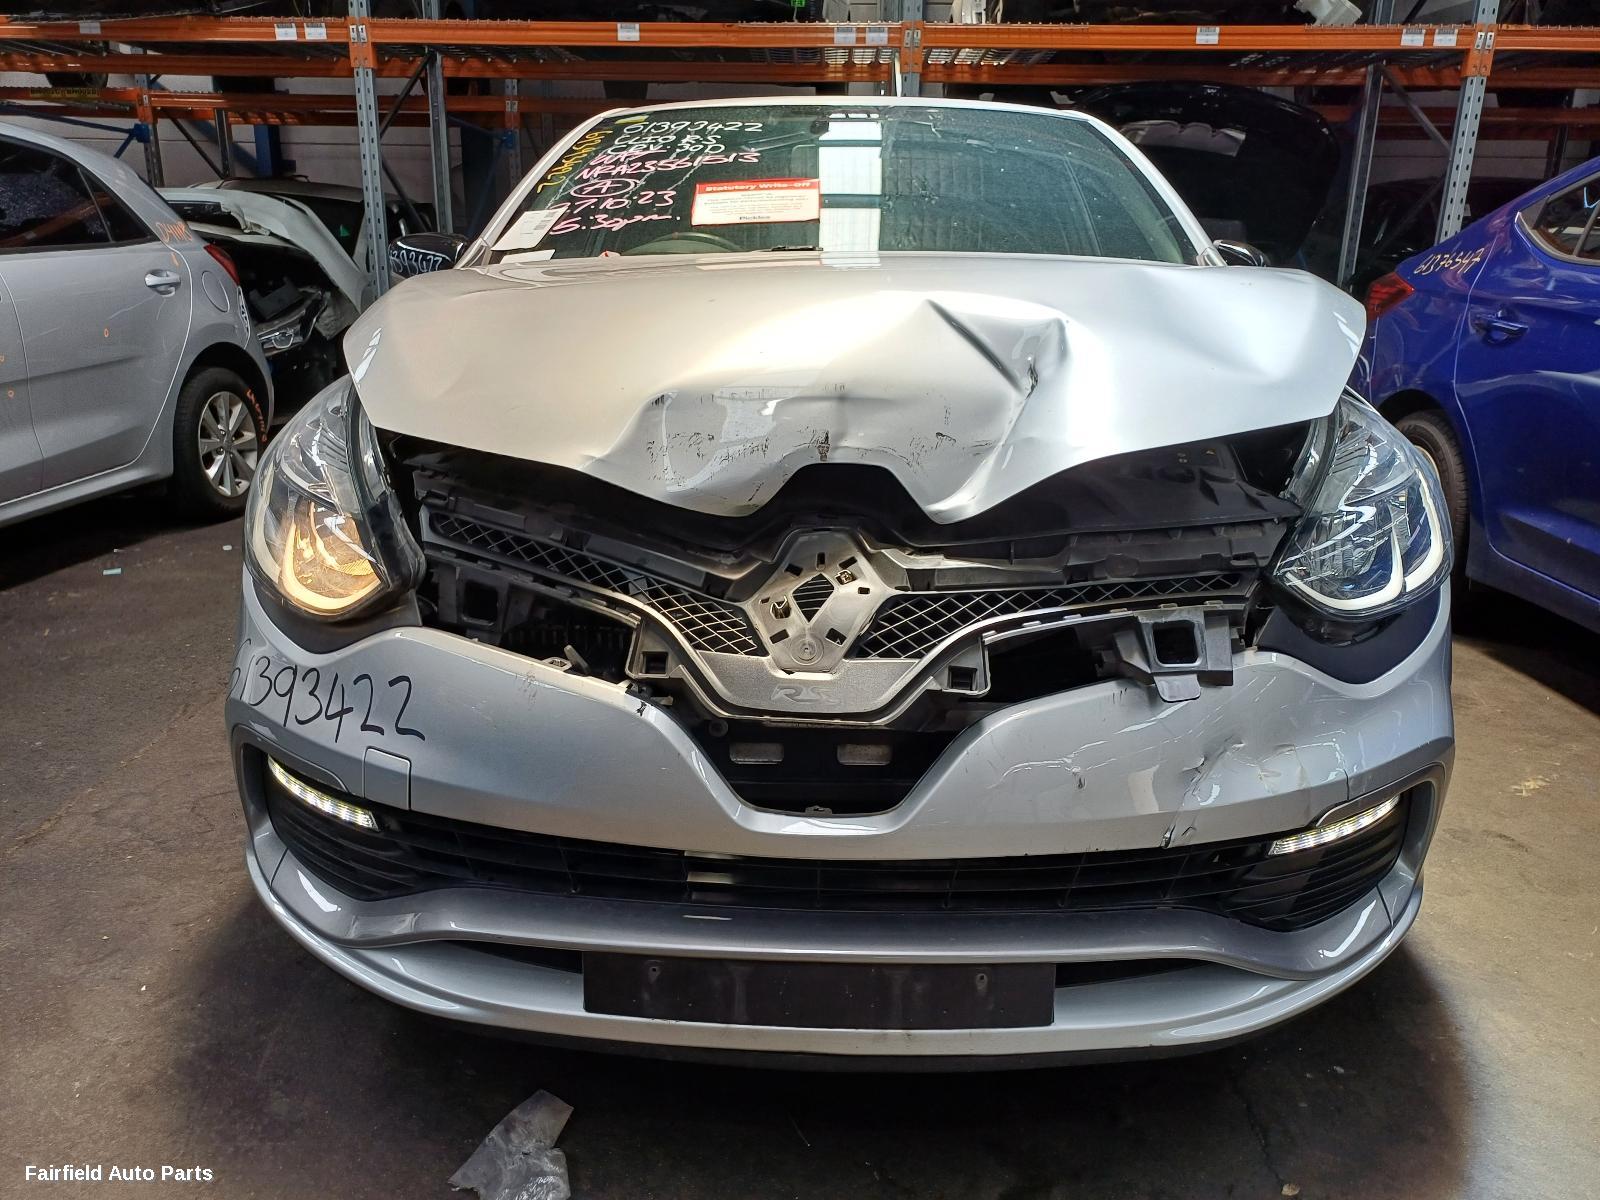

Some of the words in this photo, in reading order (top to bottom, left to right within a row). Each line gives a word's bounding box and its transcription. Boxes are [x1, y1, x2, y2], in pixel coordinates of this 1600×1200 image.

[614, 135, 677, 146] CLIO
[705, 183, 758, 192] Statutory
[770, 683, 843, 705] RS
